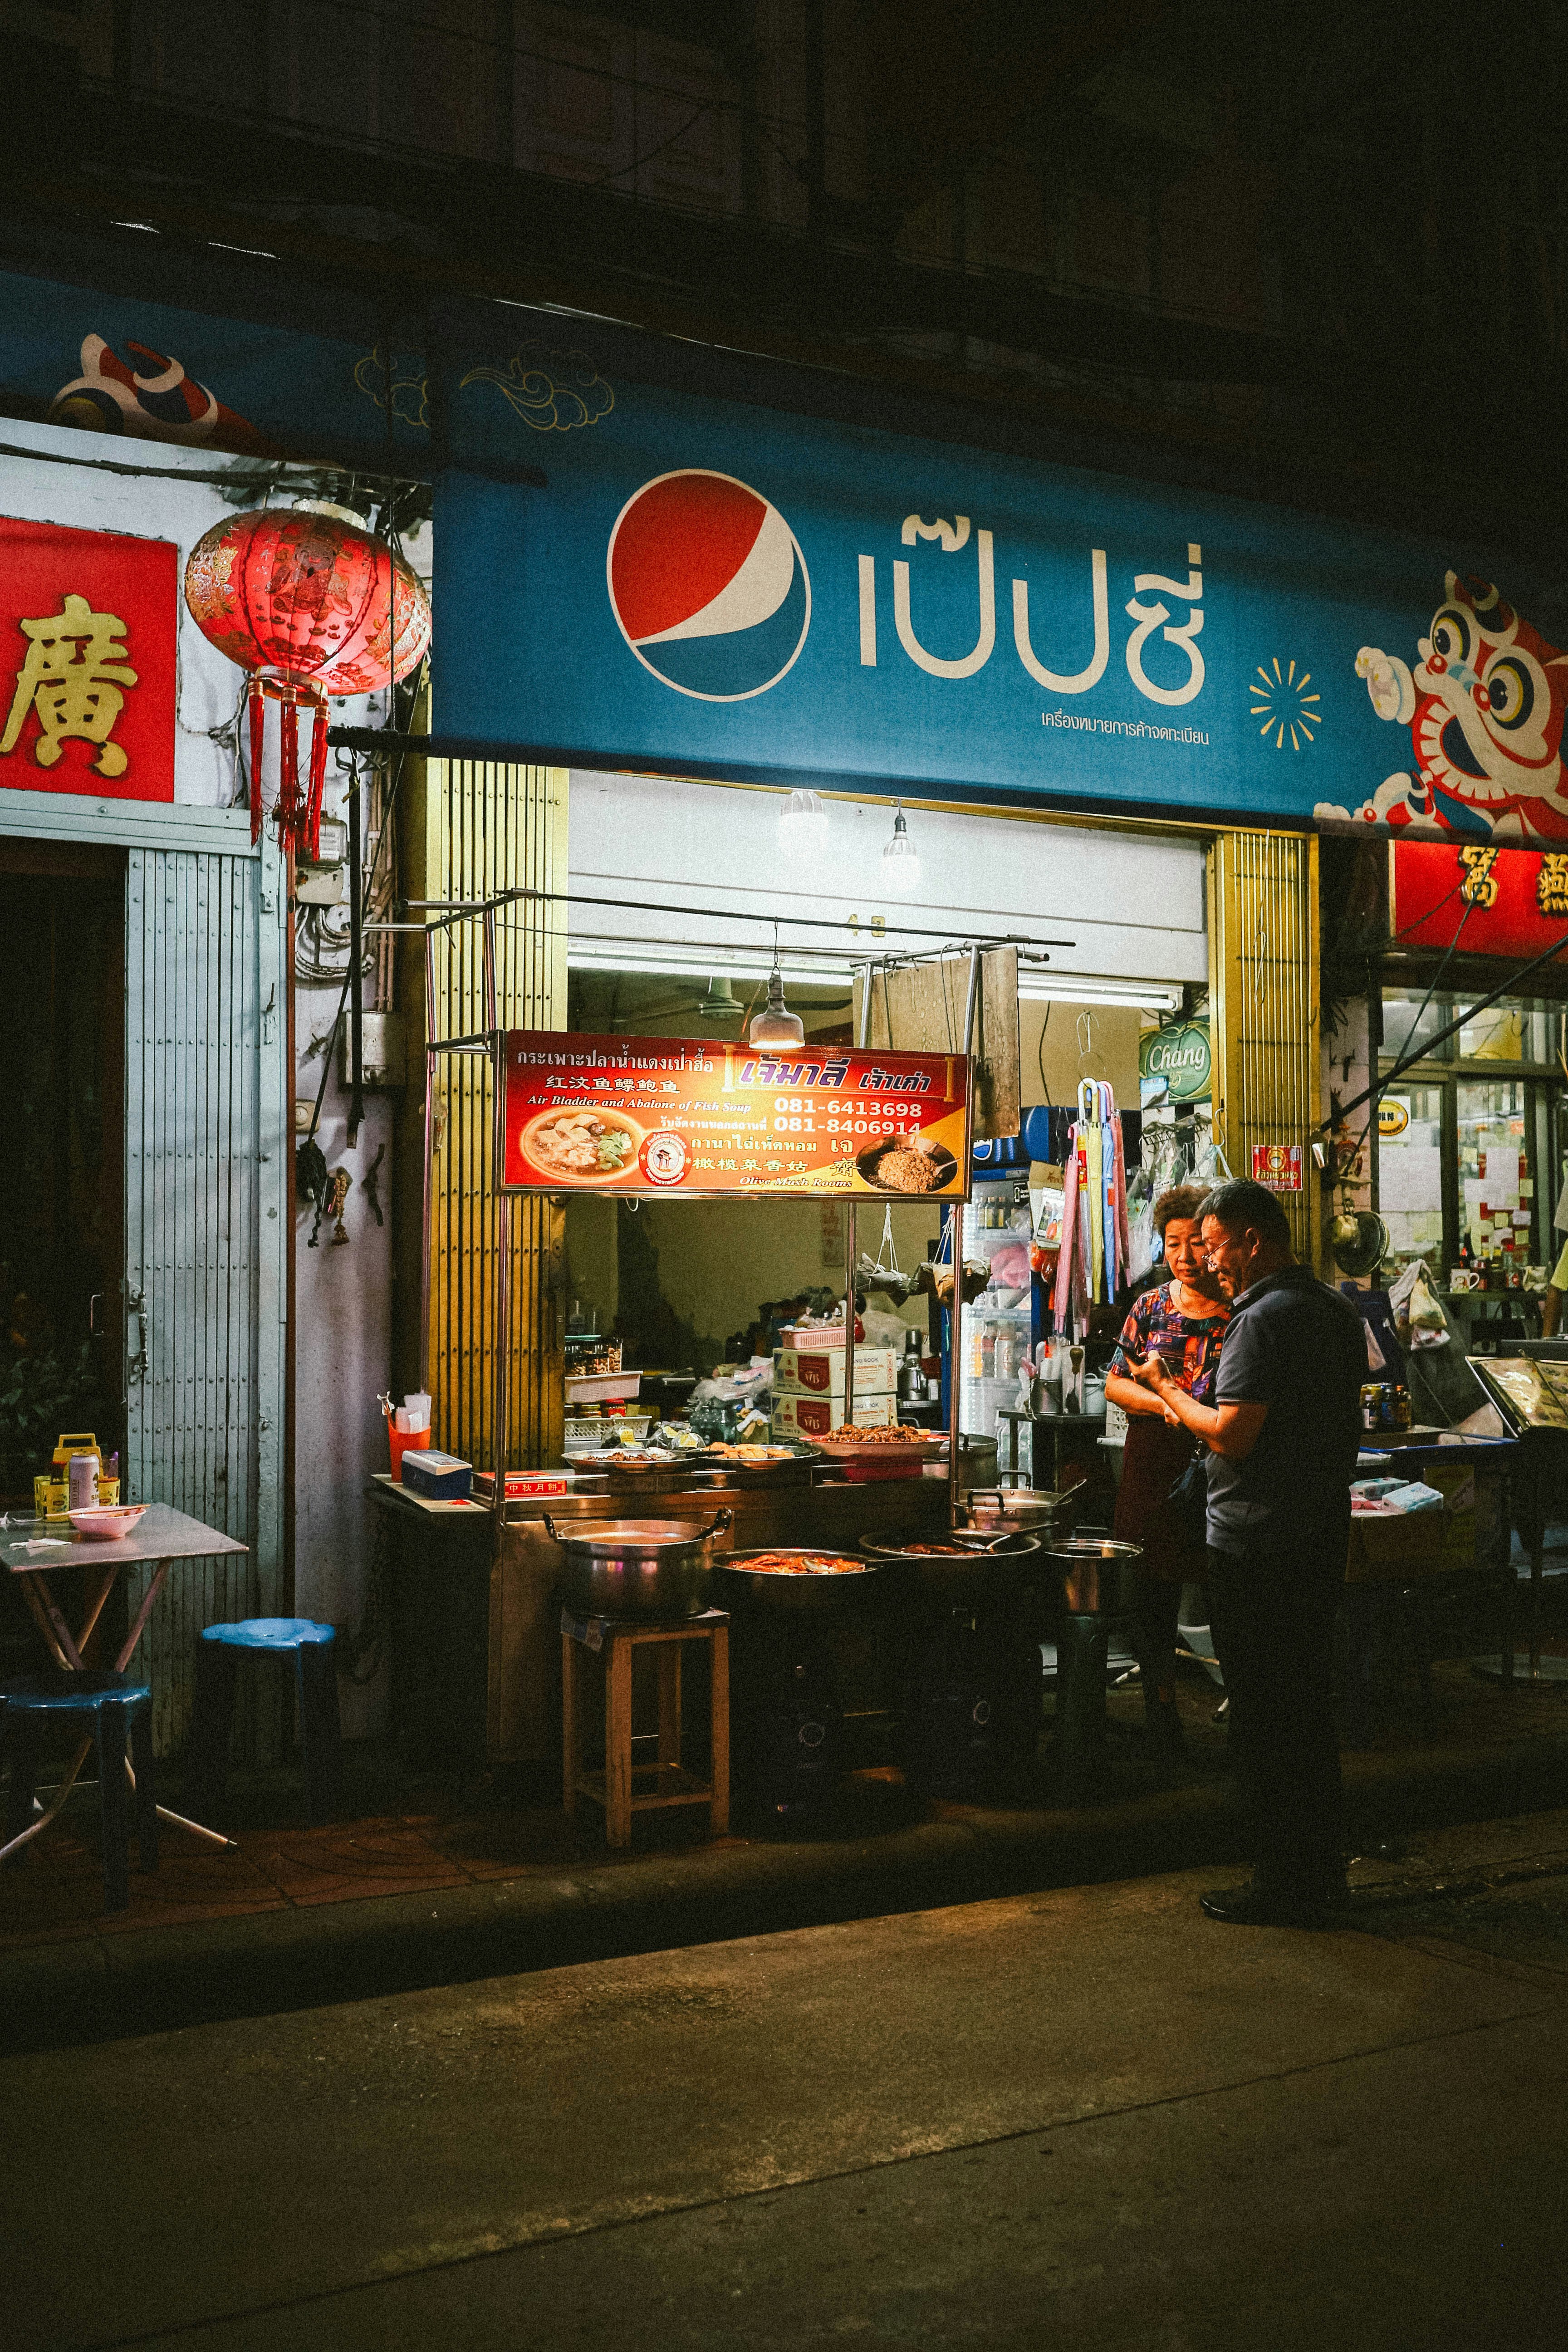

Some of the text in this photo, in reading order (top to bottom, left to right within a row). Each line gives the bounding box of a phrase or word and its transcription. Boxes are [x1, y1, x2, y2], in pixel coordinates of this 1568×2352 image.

[858, 514, 1205, 706] เป๊ปซี่
[0, 594, 137, 776] 廣
[1042, 708, 1209, 745] เครื่องหมายการค้าจดทะเบียน
[1149, 1044, 1205, 1072] Chang
[528, 1095, 751, 1114] Air Bladder and Abalone of Fish Soup
[774, 1098, 922, 1117] 081-6413698
[774, 1117, 921, 1135] 081-8406914
[830, 1138, 854, 1153] เจ
[739, 1176, 853, 1188] Olive Mush Rooms
[510, 1483, 557, 1493] 中秋月餅
